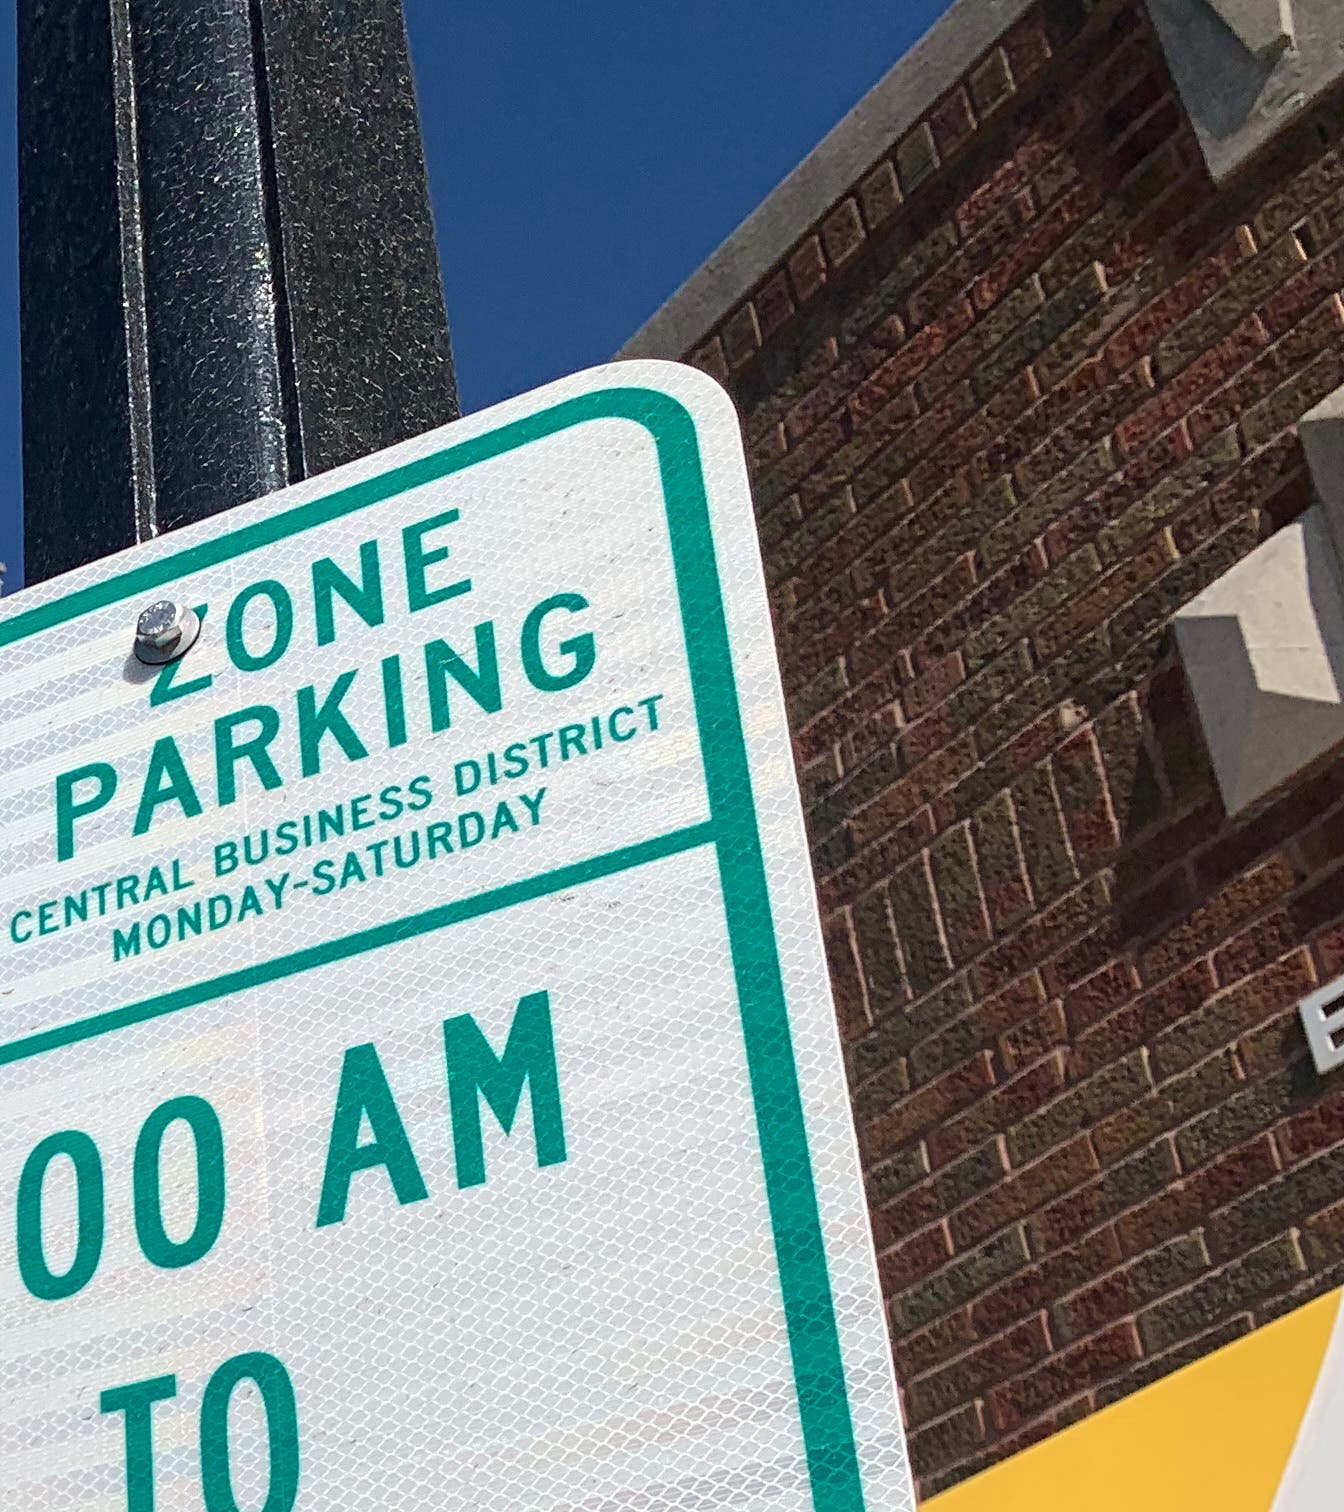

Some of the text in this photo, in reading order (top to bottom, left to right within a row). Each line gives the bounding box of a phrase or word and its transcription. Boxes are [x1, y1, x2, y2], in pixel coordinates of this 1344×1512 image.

[55, 592, 597, 862] PARKING
[149, 508, 472, 708] ZONE
[10, 694, 665, 945] CENTRAL BUSINESS DISTRICT
[112, 787, 549, 962] MONDAY-SATURDAY
[315, 990, 568, 1229] AM
